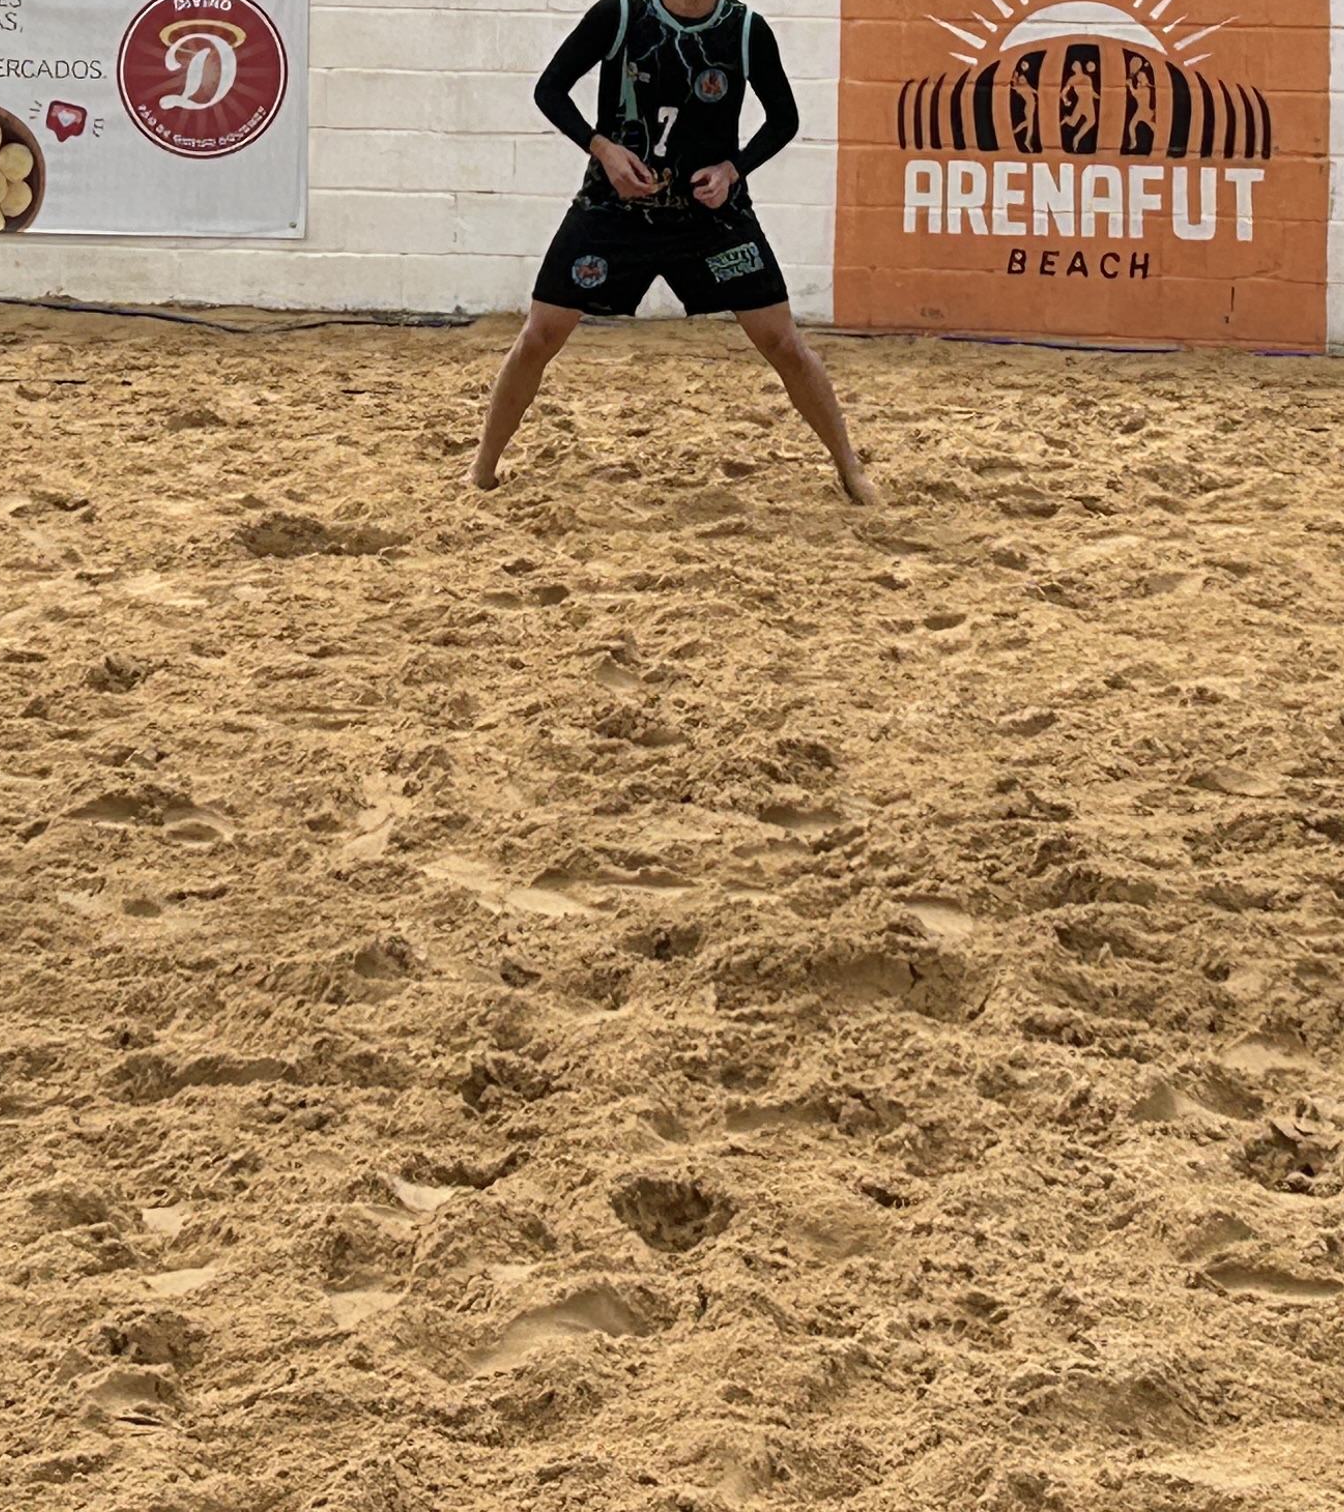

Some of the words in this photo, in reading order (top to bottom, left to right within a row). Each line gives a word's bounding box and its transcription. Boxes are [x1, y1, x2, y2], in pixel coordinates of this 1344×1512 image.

[653, 105, 680, 158] 7
[903, 159, 1266, 242] ARENAFUT
[1007, 248, 1151, 280] BEACH
